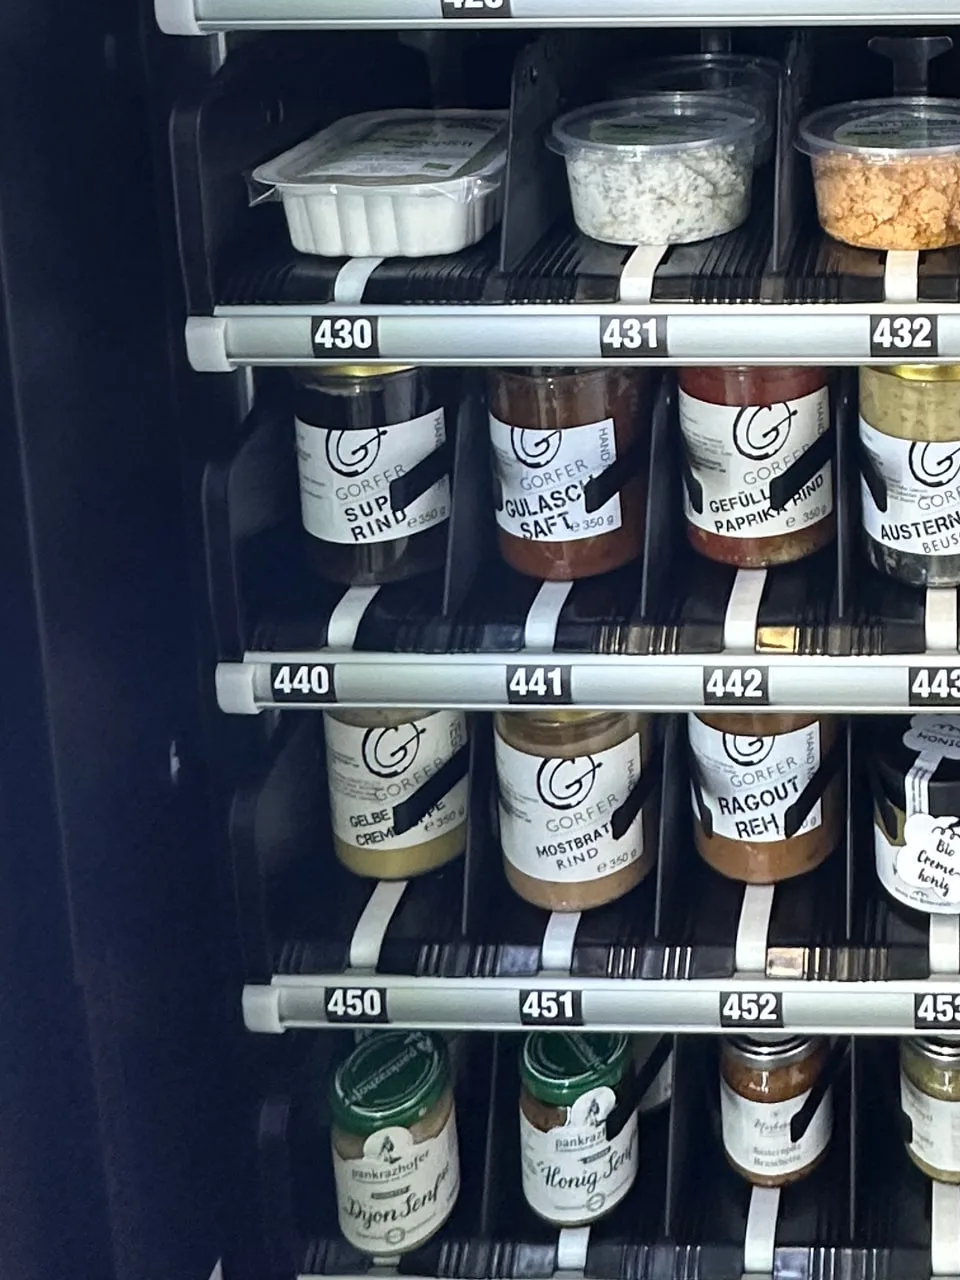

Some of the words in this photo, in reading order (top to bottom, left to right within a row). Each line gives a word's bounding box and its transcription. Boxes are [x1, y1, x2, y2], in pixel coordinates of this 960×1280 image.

[315, 319, 371, 348] 430
[603, 318, 657, 348] 431
[873, 317, 931, 347] 432
[599, 428, 613, 461] HAND
[335, 464, 407, 500] GORFER
[520, 459, 589, 491] GORFER
[709, 489, 771, 513] GEFÜLL
[792, 474, 824, 506] RIND
[350, 509, 407, 542] RIND
[520, 511, 573, 540] SAFT
[583, 516, 604, 529] 350
[802, 507, 820, 523] 350
[274, 666, 328, 693] 440
[510, 667, 561, 695] 441
[707, 668, 762, 697] 442
[730, 756, 798, 788] GORFER
[718, 776, 799, 816] RAGOUT
[350, 809, 391, 828] GELBE
[546, 793, 619, 833] GORFER
[735, 813, 780, 839] REH
[536, 823, 612, 858] MOSTBRAT
[936, 839, 955, 857] Bio
[556, 847, 599, 870] RIND
[609, 853, 628, 869] 350
[918, 868, 950, 897] honig
[328, 989, 381, 1015] 450
[523, 991, 572, 1017] 451
[723, 993, 776, 1020] 452
[352, 1149, 430, 1180] pankrazhofer
[538, 1161, 598, 1194] Honig
